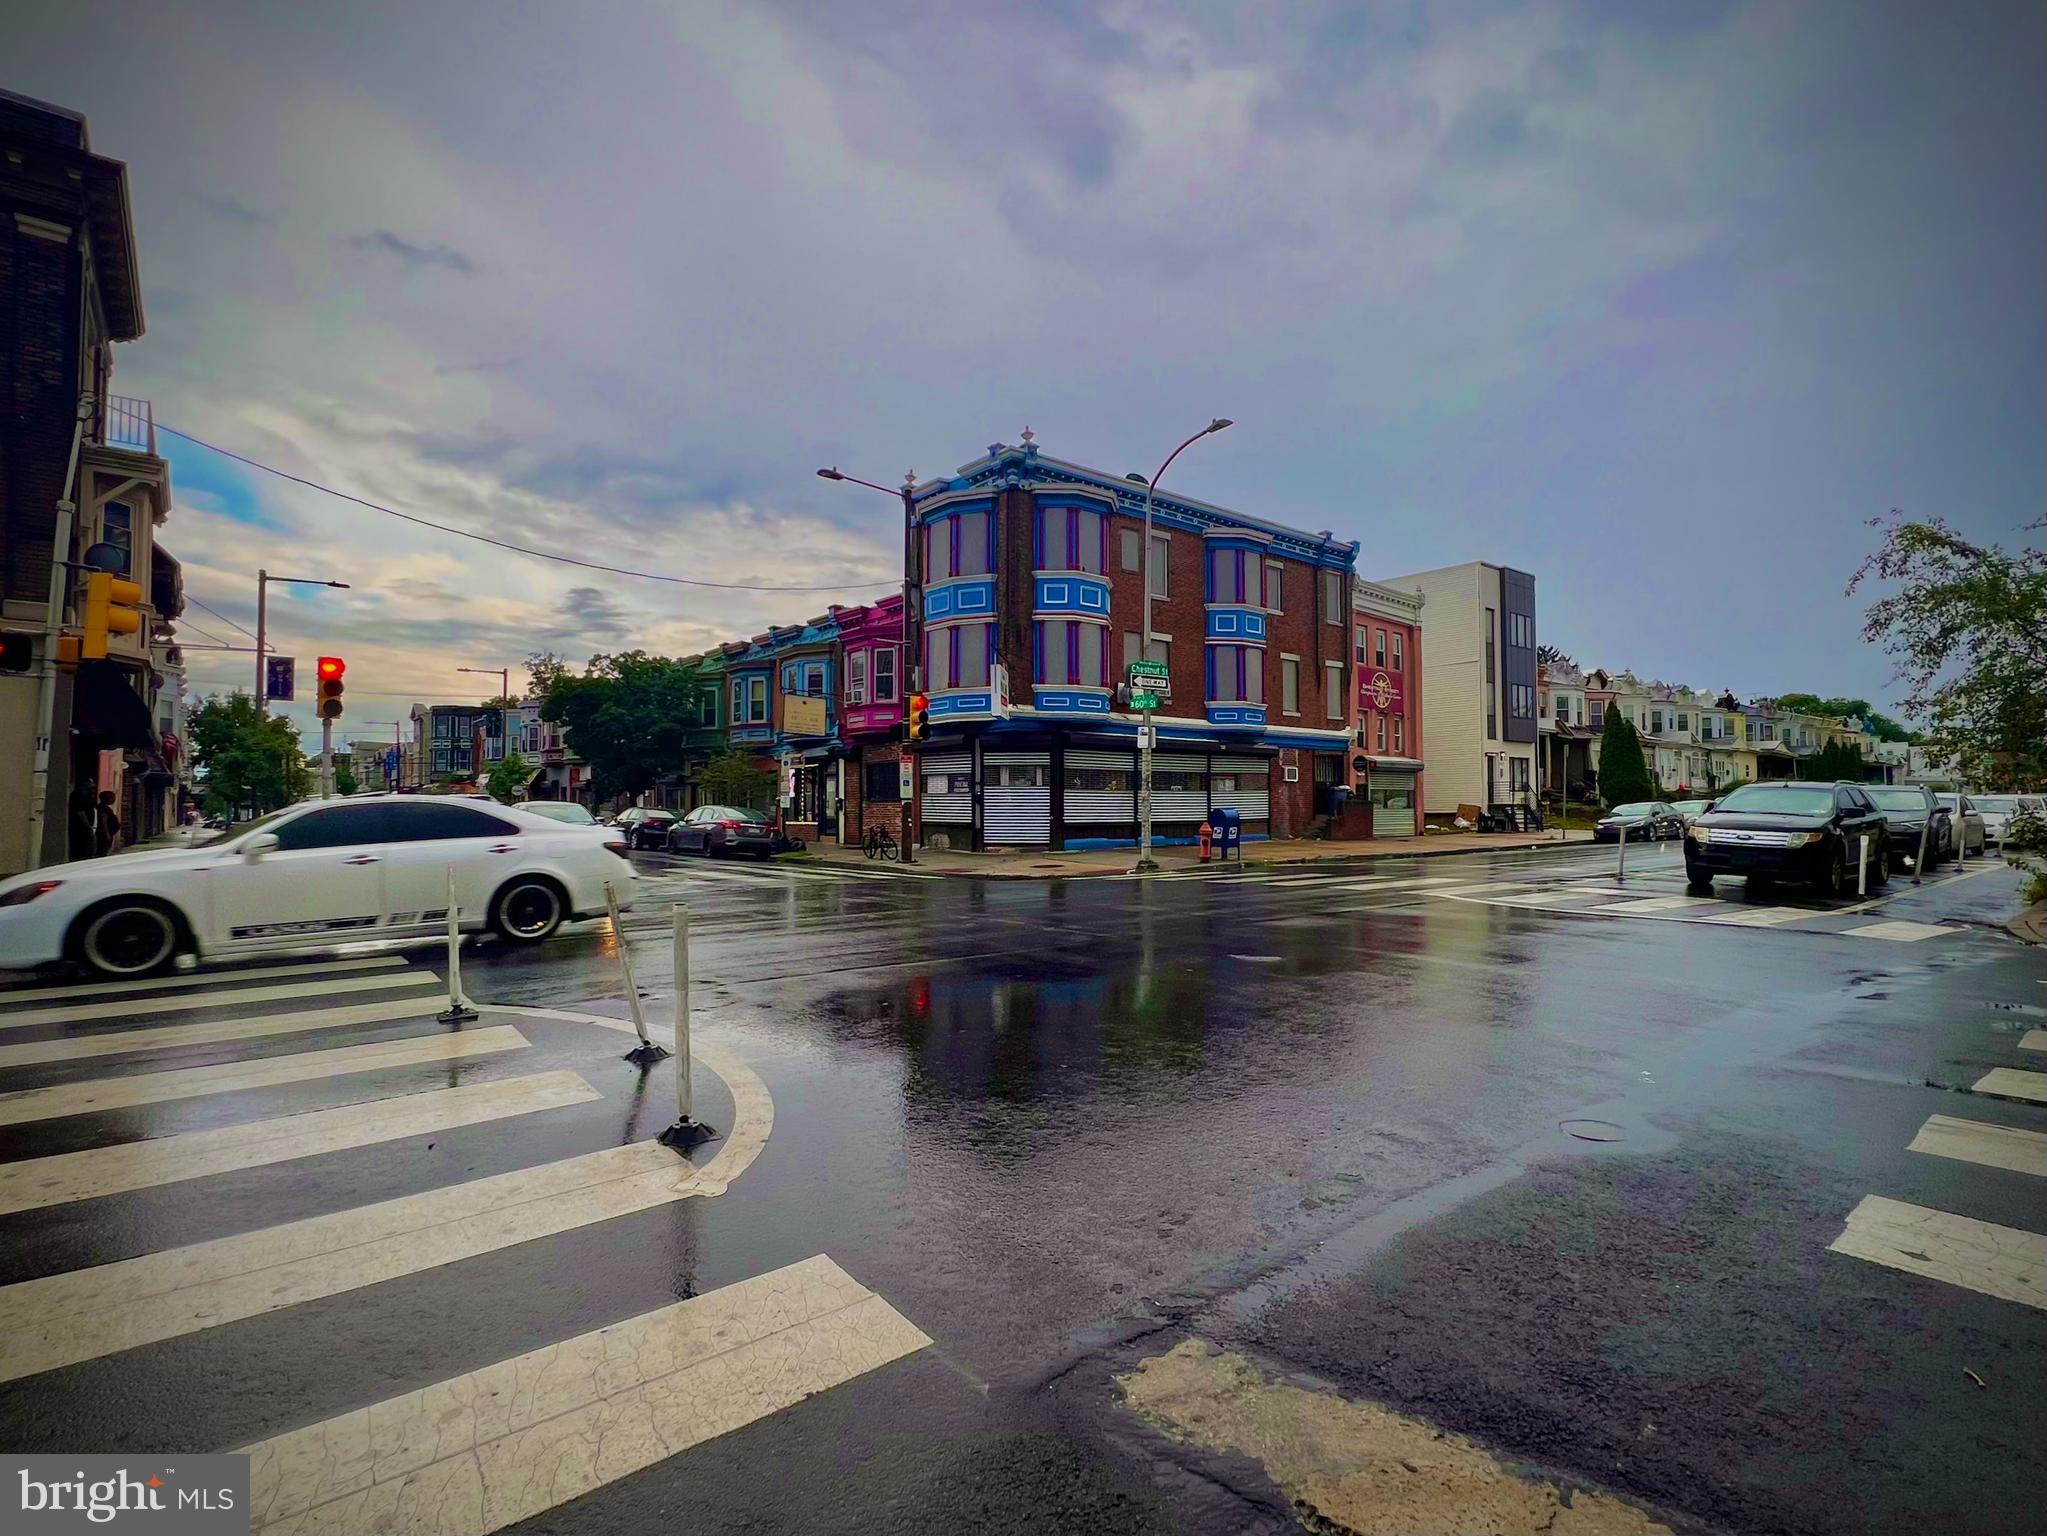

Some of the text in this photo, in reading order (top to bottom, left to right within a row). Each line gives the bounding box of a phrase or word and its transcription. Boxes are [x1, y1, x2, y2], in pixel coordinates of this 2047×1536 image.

[1131, 664, 1168, 675] Chestnut St
[1149, 699, 1156, 707] St
